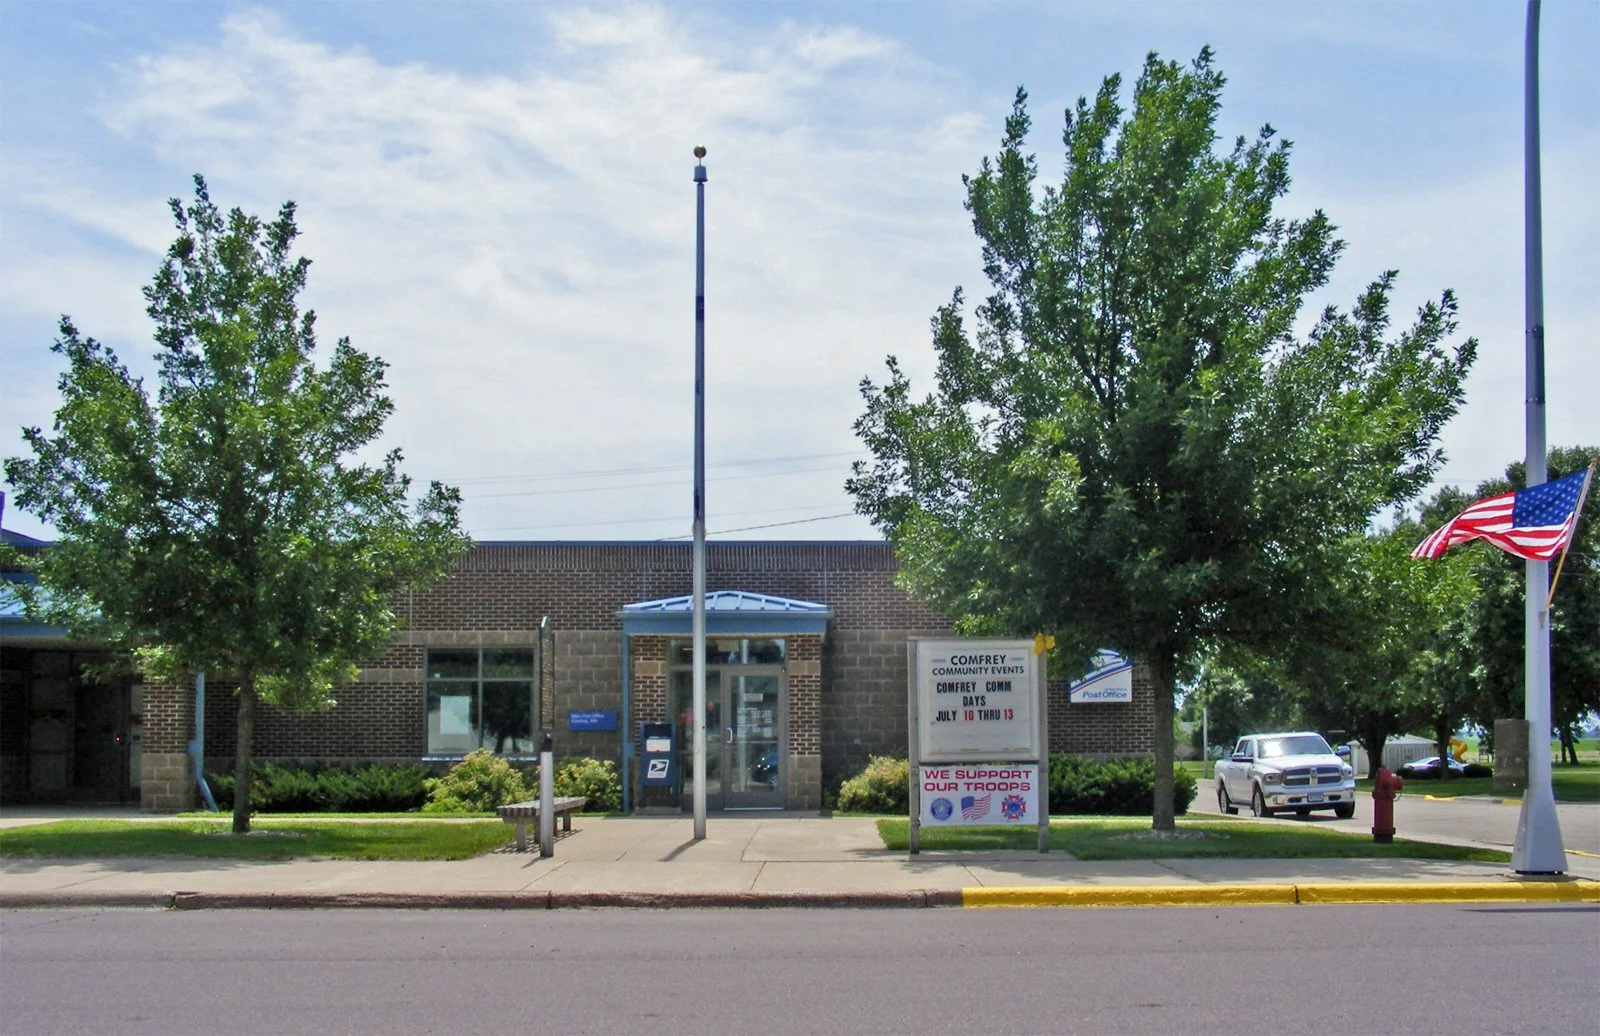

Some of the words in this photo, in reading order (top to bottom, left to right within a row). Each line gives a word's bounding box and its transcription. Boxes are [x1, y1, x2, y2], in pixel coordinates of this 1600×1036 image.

[951, 655, 1006, 665] COMFREY
[932, 667, 988, 675] COMMUNITY
[991, 666, 1024, 674] EVENTS
[937, 682, 976, 693] COMFREY
[986, 681, 1012, 692] COMM
[963, 696, 986, 707] DAYS
[936, 710, 957, 721] JULY
[964, 710, 974, 720] 10
[978, 709, 1000, 720] THRU
[1004, 709, 1014, 719] 13
[924, 770, 950, 779] WE
[955, 770, 1032, 779] SUPPORT
[924, 782, 958, 792] OUR
[964, 782, 1031, 792] TROOPS
